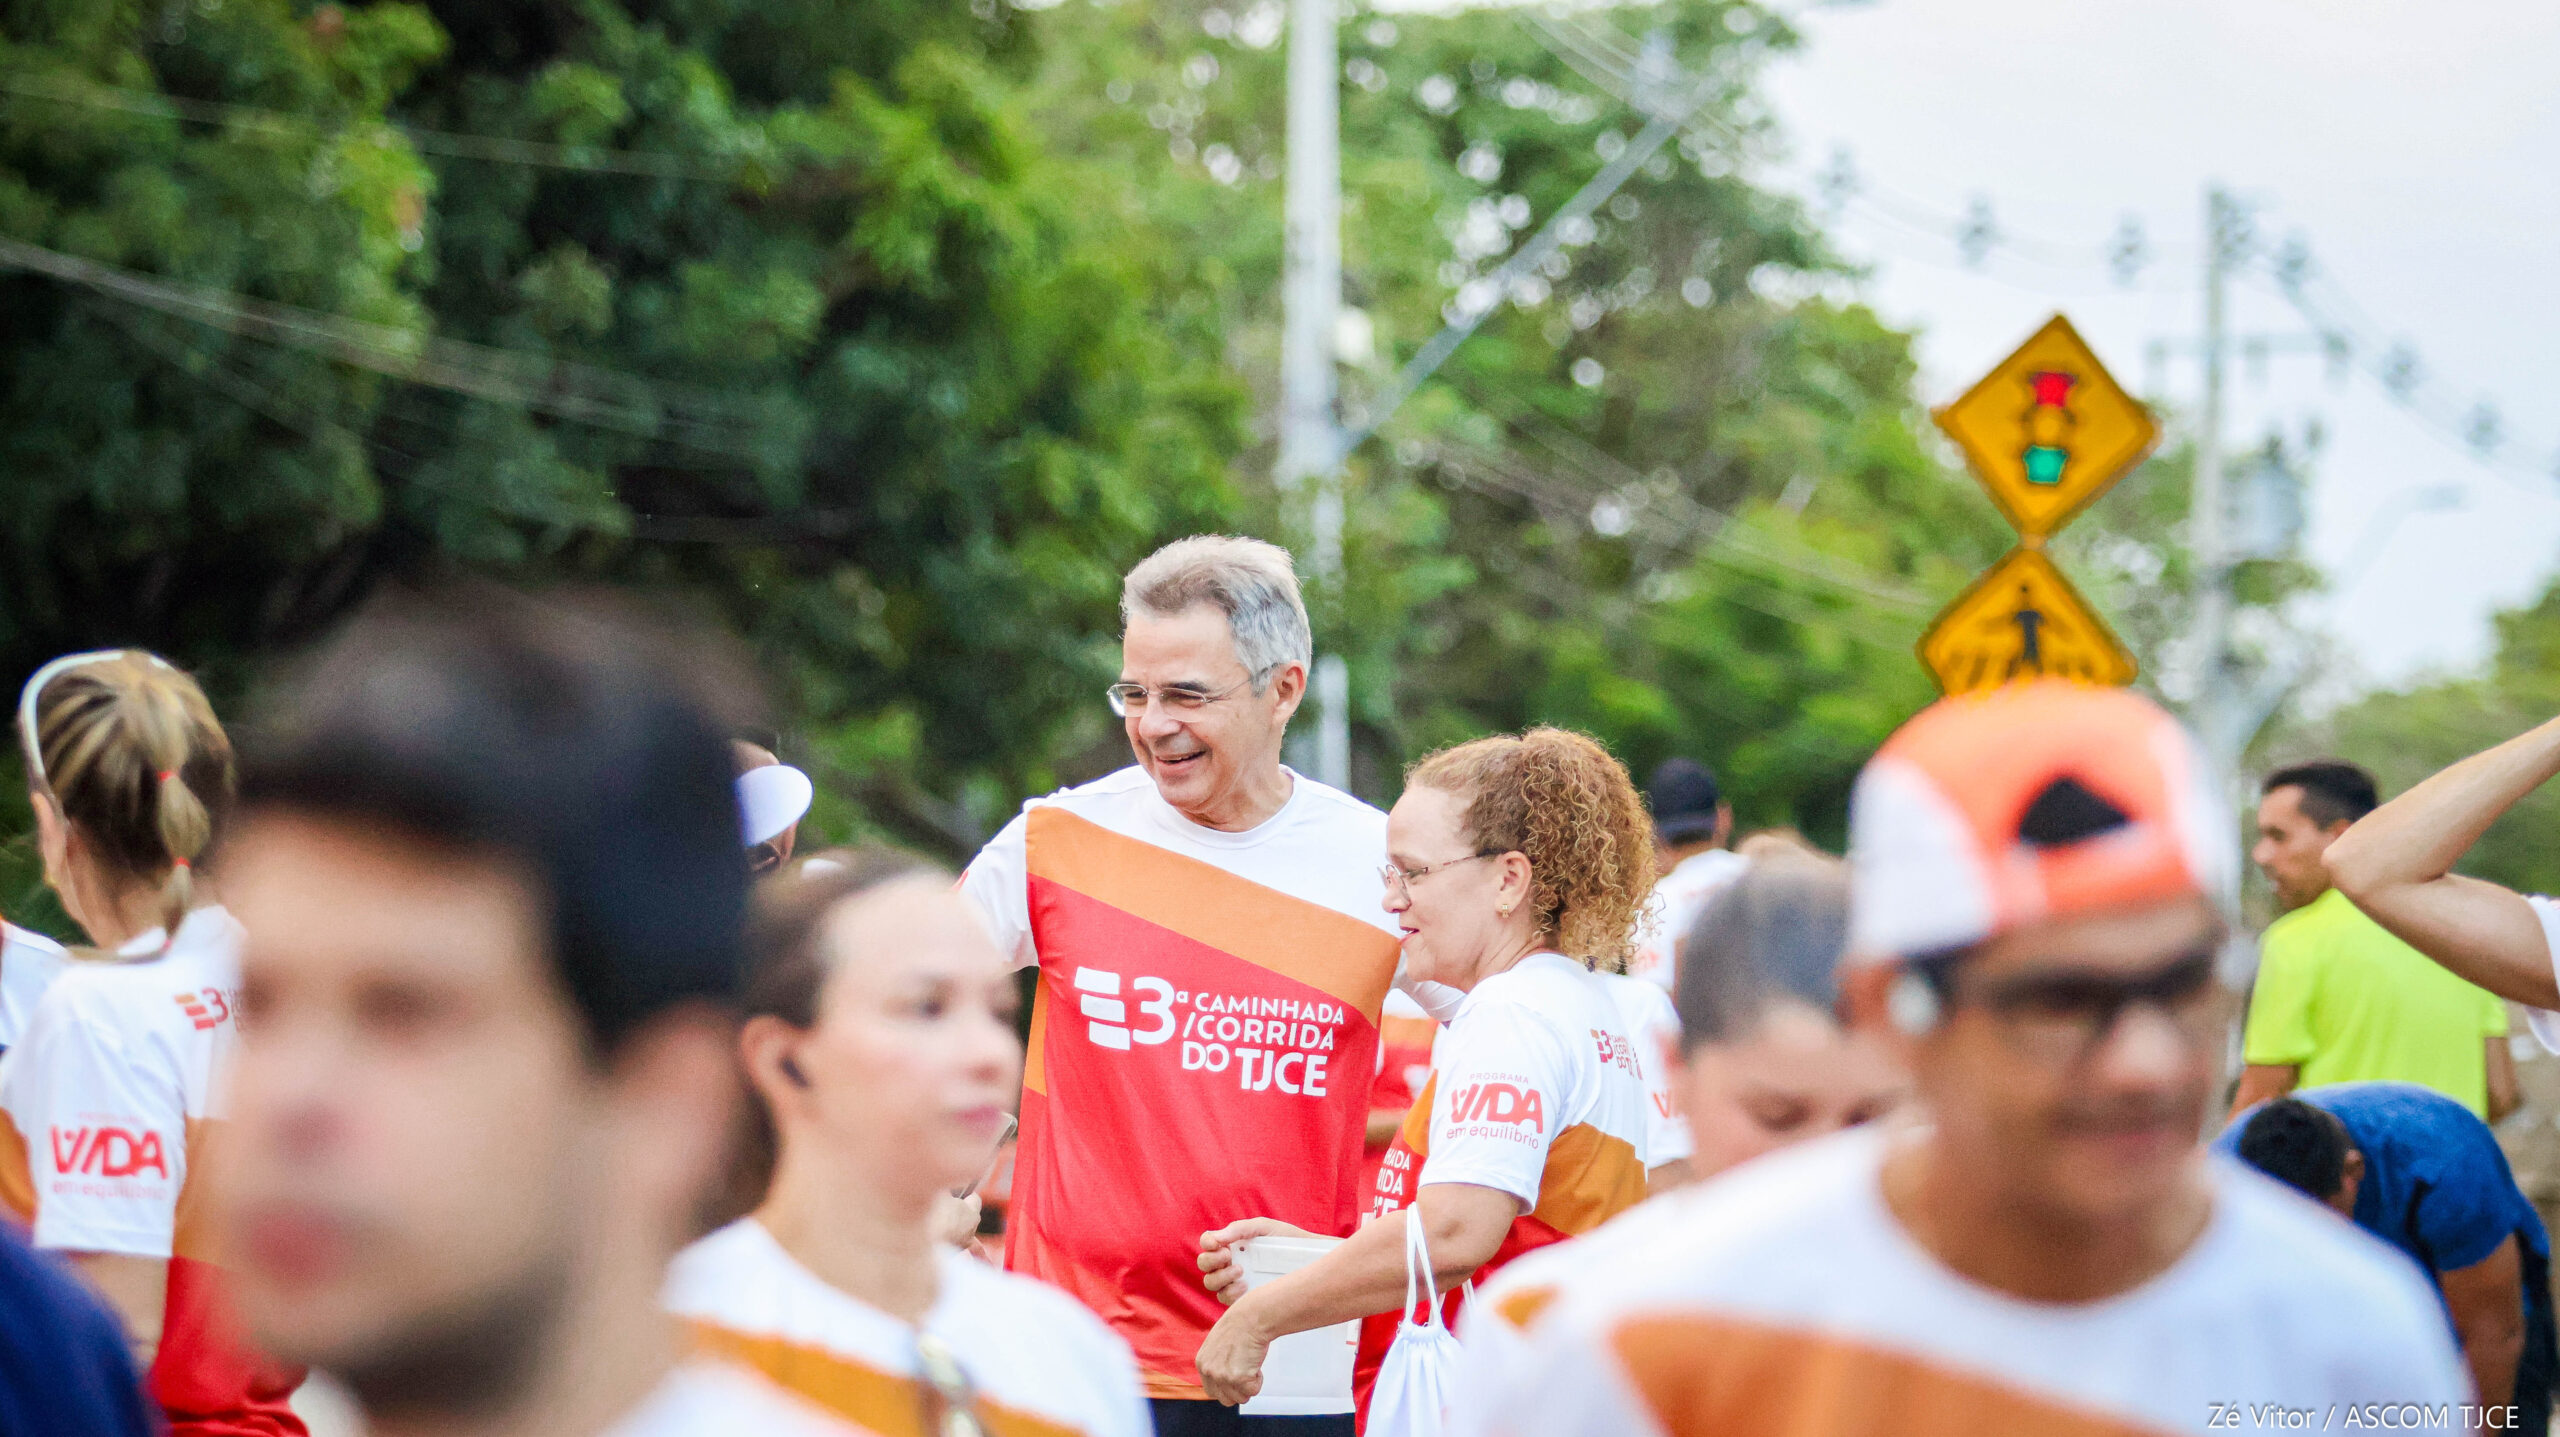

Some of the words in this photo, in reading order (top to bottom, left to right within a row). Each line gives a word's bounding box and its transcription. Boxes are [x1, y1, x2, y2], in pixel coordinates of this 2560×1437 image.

[1195, 992, 1344, 1026] CAMINHADA
[1182, 1011, 1335, 1051] /CORRIDA
[1182, 1041, 1230, 1072] DO
[1235, 1047, 1328, 1097] TJCE
[1469, 1072, 1529, 1084] PROGRAMA
[1450, 1082, 1543, 1134] VIDA
[50, 1125, 168, 1180] VIDA
[1446, 1126, 1466, 1139] em
